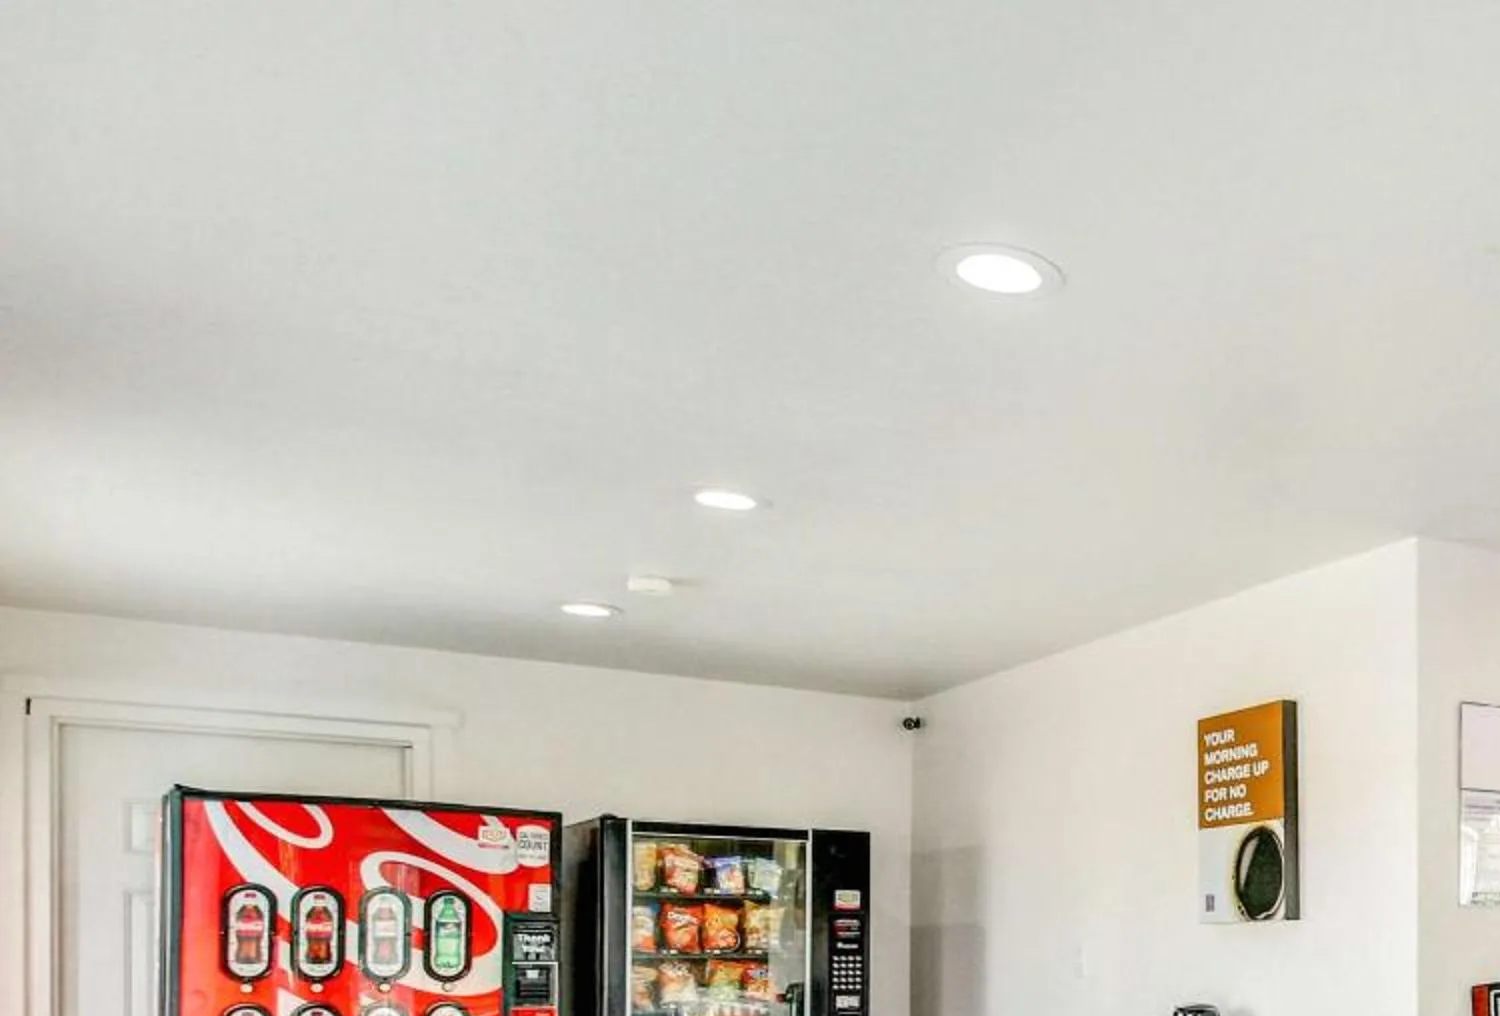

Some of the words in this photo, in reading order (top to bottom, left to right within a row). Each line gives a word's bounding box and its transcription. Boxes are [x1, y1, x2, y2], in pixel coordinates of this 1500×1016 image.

[1204, 729, 1235, 747] YOUR
[1204, 743, 1258, 766] MORNING
[1205, 763, 1251, 785] CHARGE
[1253, 760, 1269, 777] UP
[1205, 787, 1227, 803] FOR
[1230, 783, 1247, 799] NO
